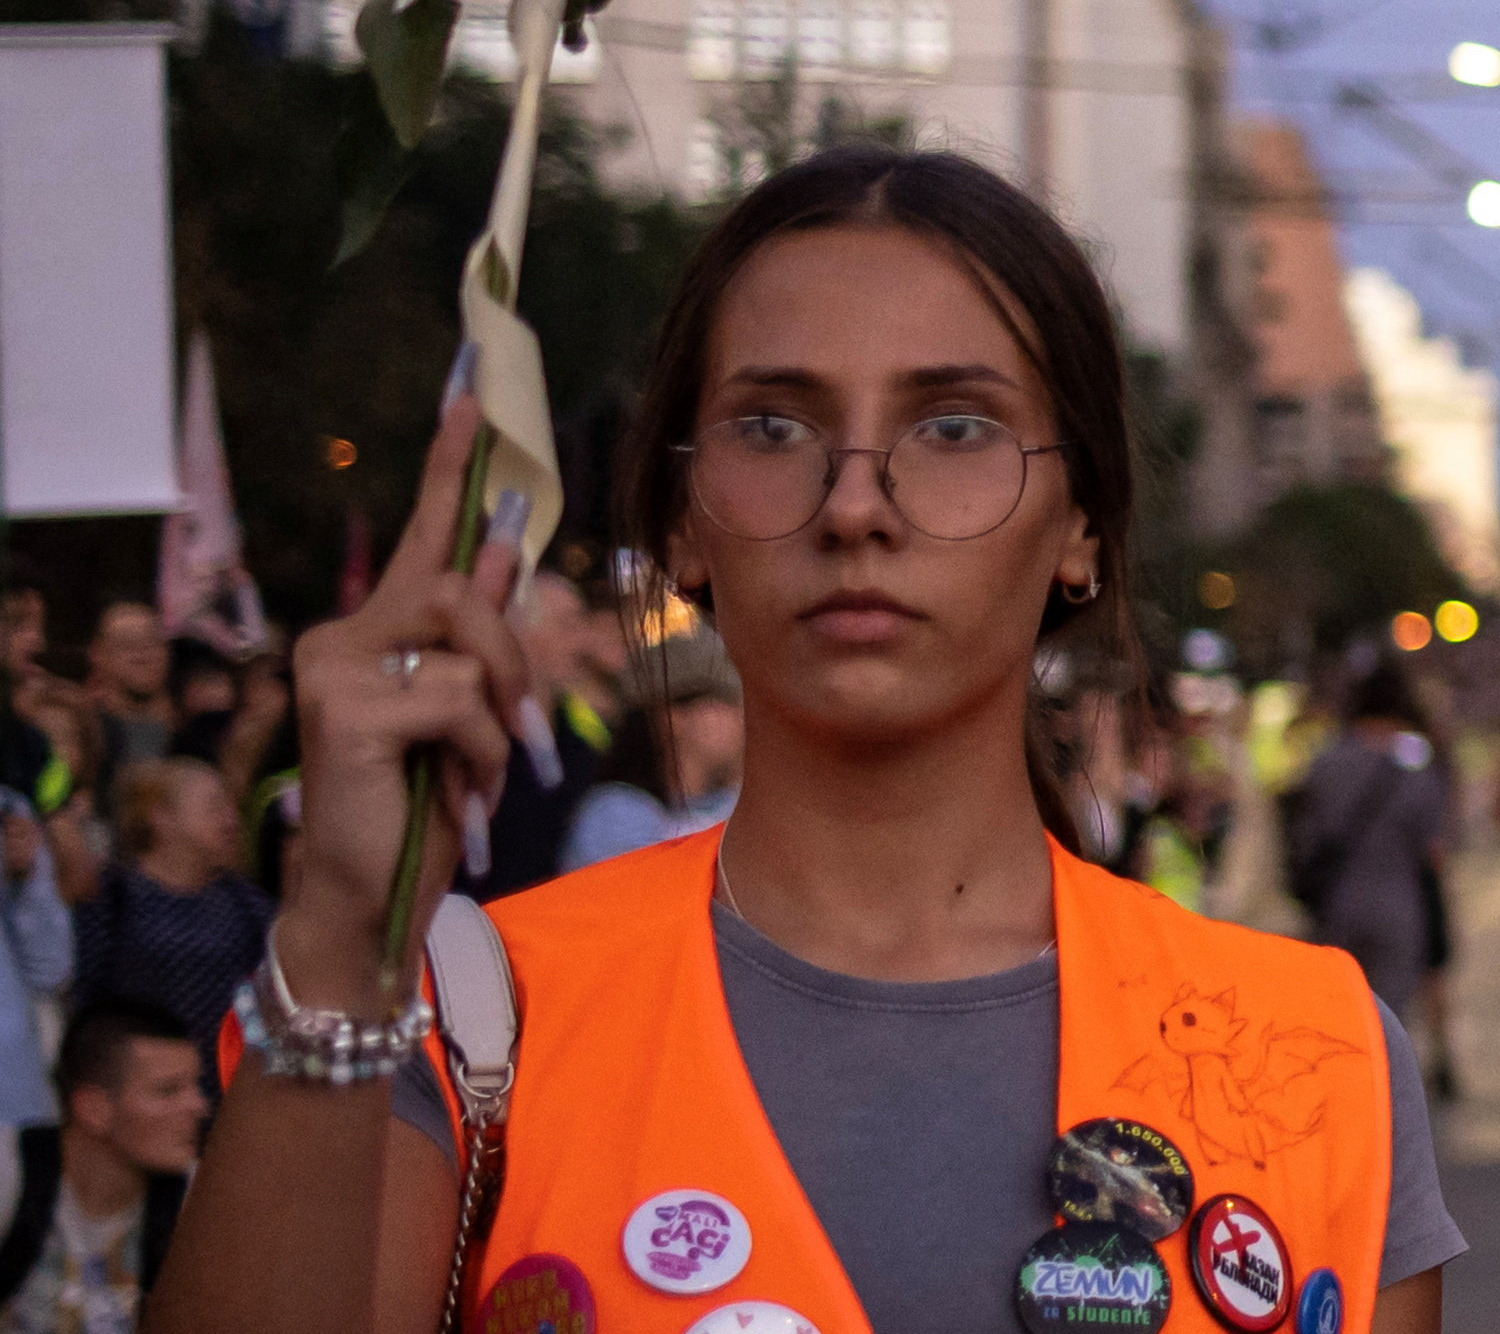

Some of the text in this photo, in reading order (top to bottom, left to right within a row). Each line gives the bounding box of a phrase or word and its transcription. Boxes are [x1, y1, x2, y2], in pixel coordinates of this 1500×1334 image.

[1114, 1122, 1186, 1177] 1.650.000
[1034, 1263, 1152, 1302] ZEMUN
[1066, 1306, 1151, 1326] STUDENTE
